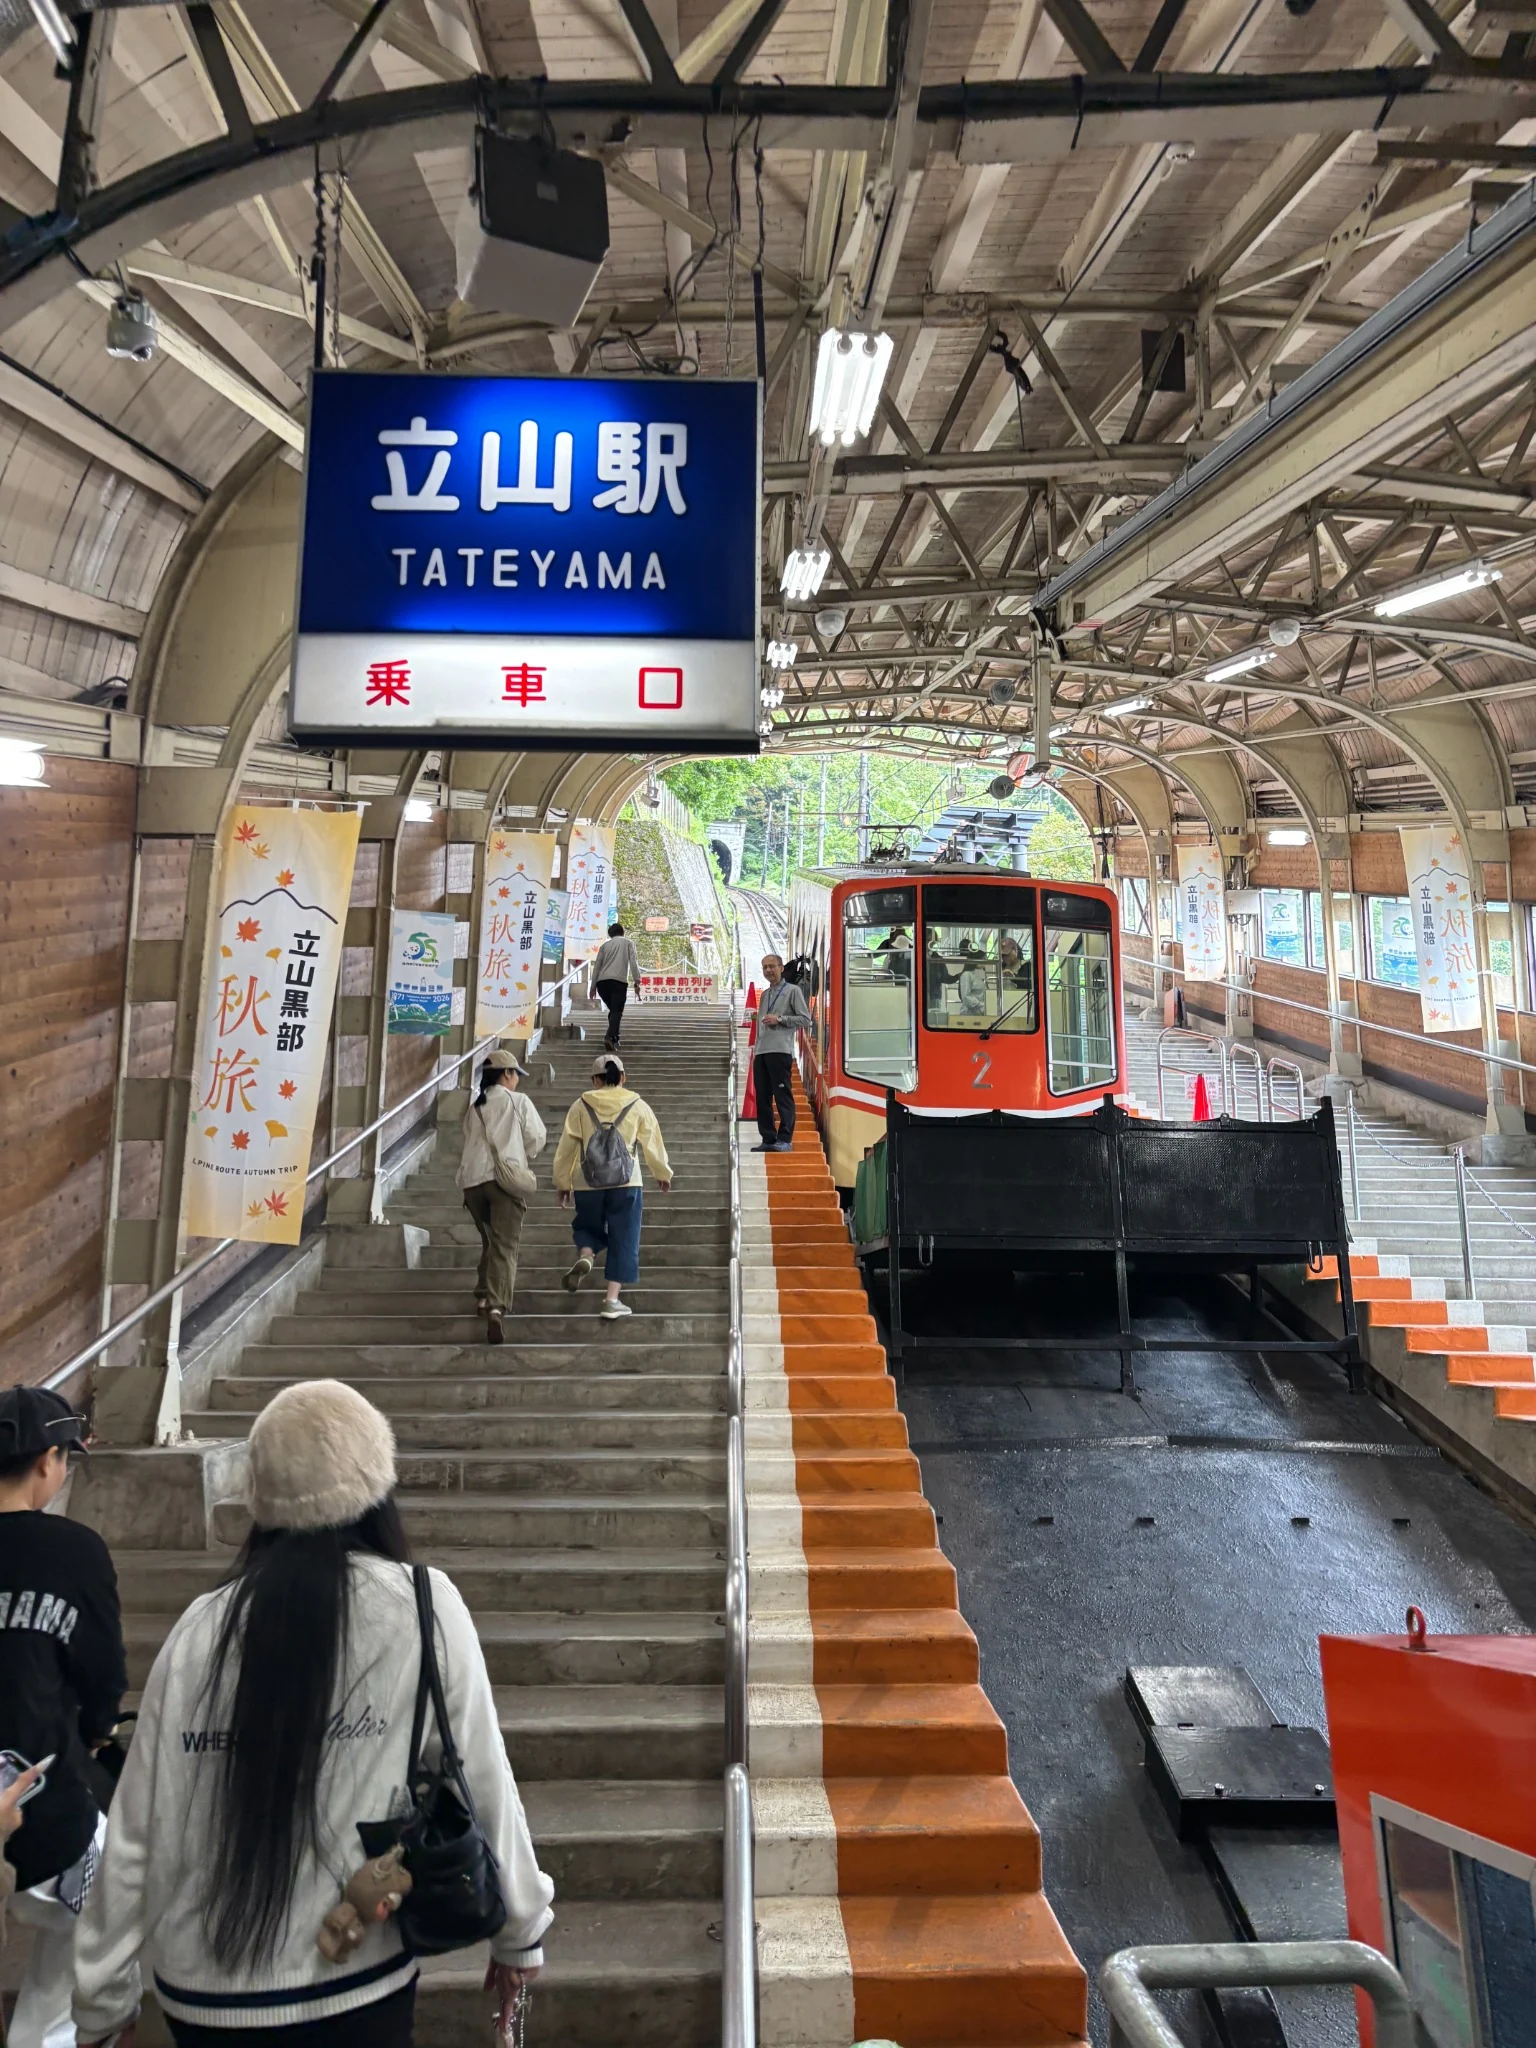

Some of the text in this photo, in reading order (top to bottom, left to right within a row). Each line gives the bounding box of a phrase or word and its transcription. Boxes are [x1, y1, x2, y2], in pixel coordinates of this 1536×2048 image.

[370, 415, 688, 516] 立山駅
[391, 547, 667, 590] TATEYAMA
[365, 658, 683, 710] 乗車口
[568, 878, 590, 922] 秋旅
[593, 864, 606, 905] 立山黒部
[519, 890, 538, 951] 立山黒部
[482, 913, 517, 981] 秋旅
[276, 929, 321, 1053] 立山黒部
[432, 994, 450, 1003] 2026
[640, 976, 713, 987] 乗車最前列は
[197, 973, 272, 1114] 秋旅
[970, 1052, 994, 1090] 2
[215, 1165, 241, 1175] ROUTE
[244, 1168, 276, 1176] AUTUMN
[278, 1165, 298, 1174] TRIP
